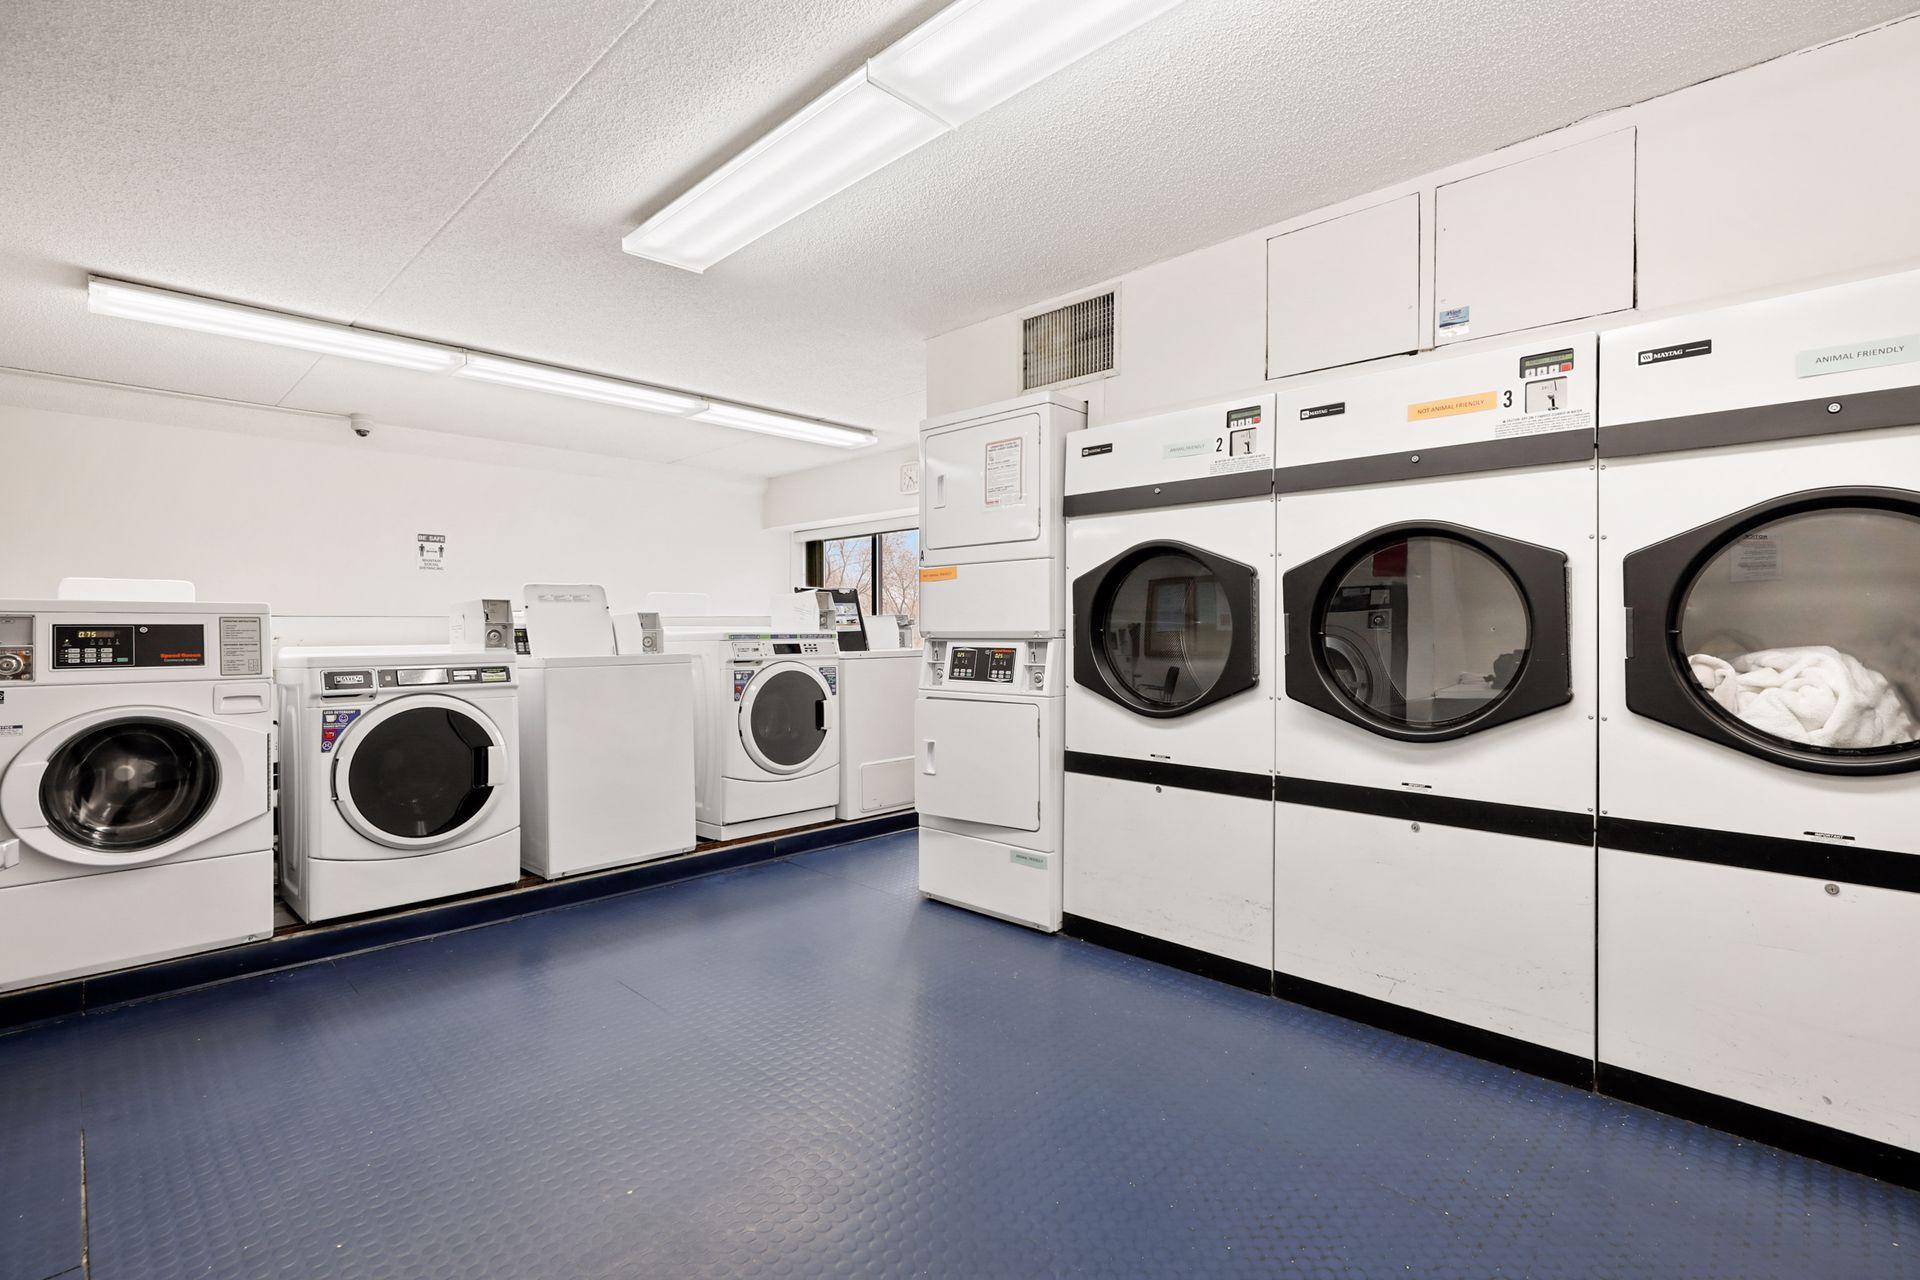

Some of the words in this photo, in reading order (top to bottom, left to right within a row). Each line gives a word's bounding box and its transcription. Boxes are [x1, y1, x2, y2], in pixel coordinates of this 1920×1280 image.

[1653, 349, 1683, 359] MAYTAG
[1815, 352, 1854, 364] ANIMAL
[1856, 345, 1905, 358] FRIENDLY
[1431, 404, 1454, 412] ANIMAL
[1455, 399, 1485, 408] FRIENDLY
[1503, 390, 1513, 408] 3
[1216, 437, 1223, 452] 2
[920, 550, 924, 561] A
